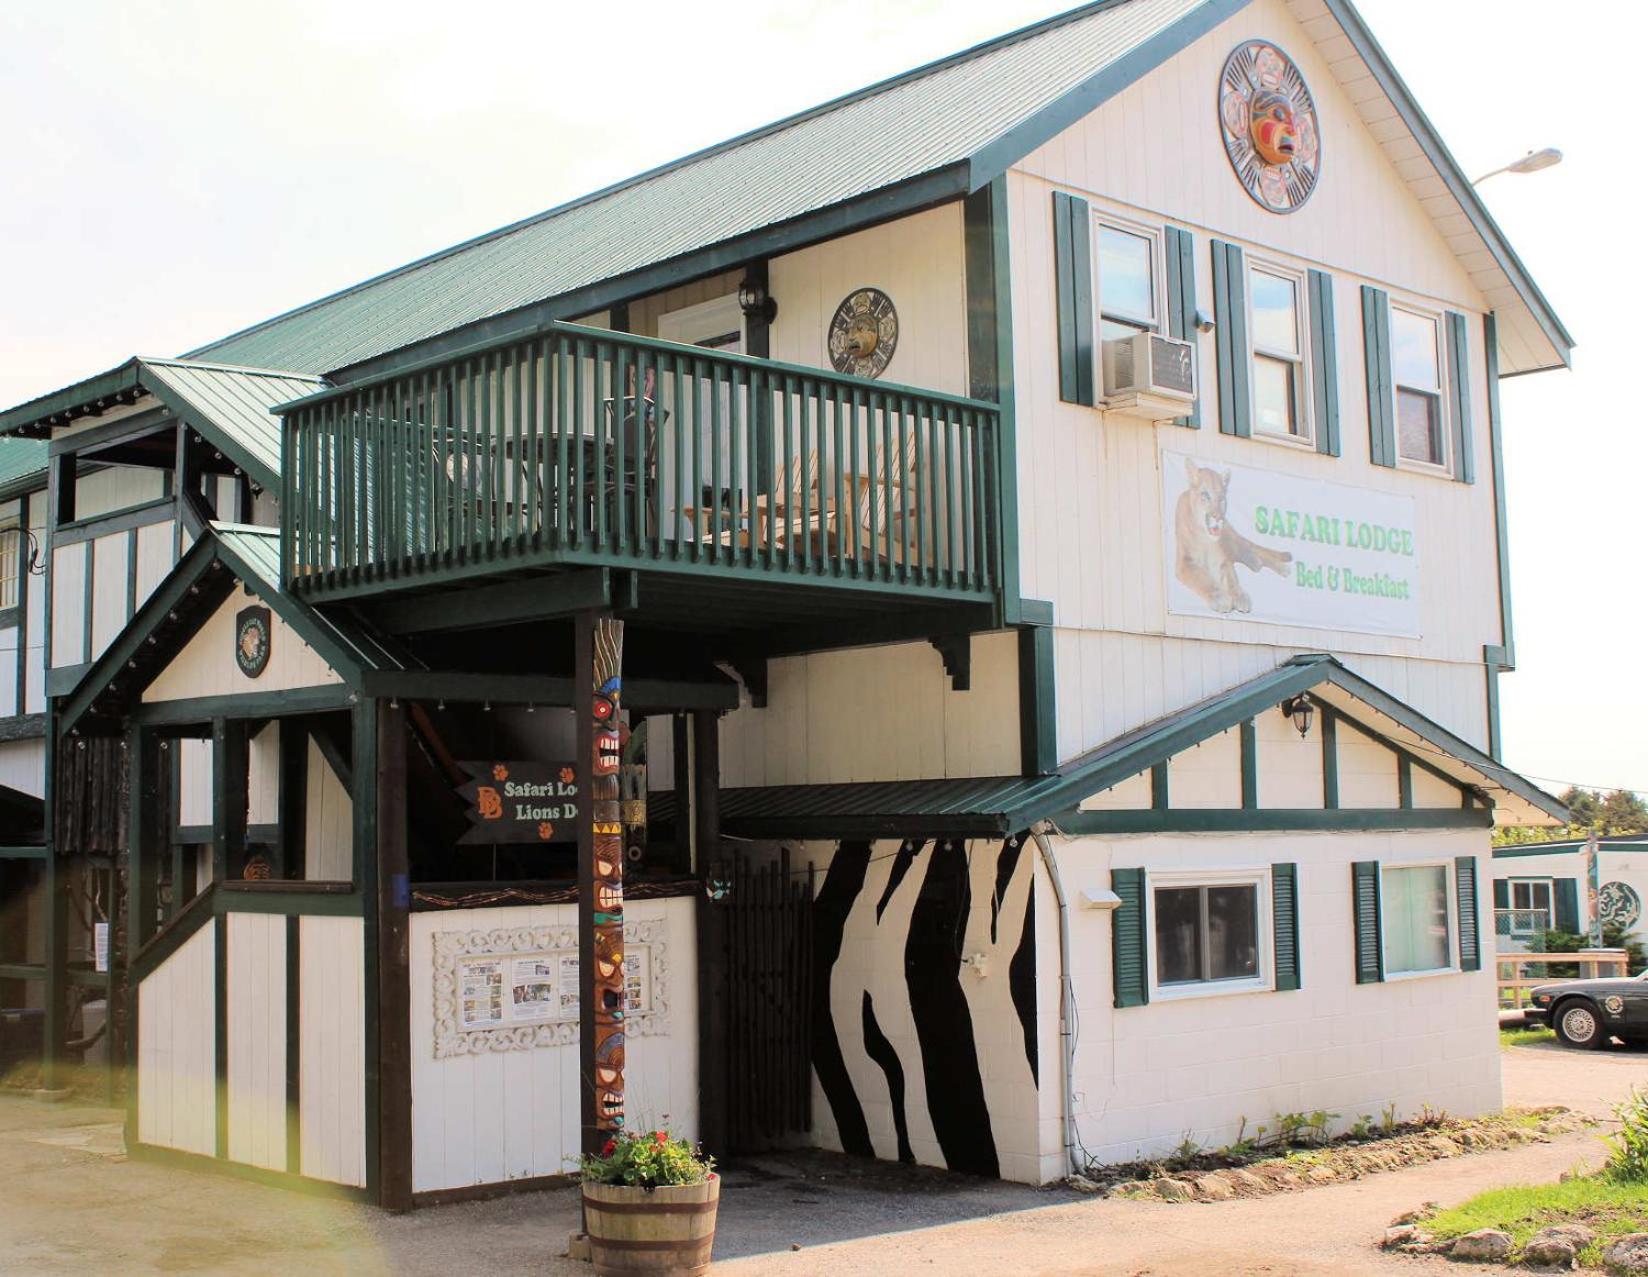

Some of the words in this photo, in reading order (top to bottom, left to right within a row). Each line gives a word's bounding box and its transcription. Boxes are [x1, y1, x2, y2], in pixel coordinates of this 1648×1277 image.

[1254, 505, 1341, 547] SAFARI
[1344, 519, 1414, 556] LODGE
[1296, 561, 1324, 589] Bed
[1327, 565, 1340, 592] &
[1343, 566, 1410, 600] Breakfast
[503, 781, 554, 798] Safari
[557, 782, 579, 797] Lo
[515, 804, 560, 821] Lions
[563, 803, 579, 820] D
